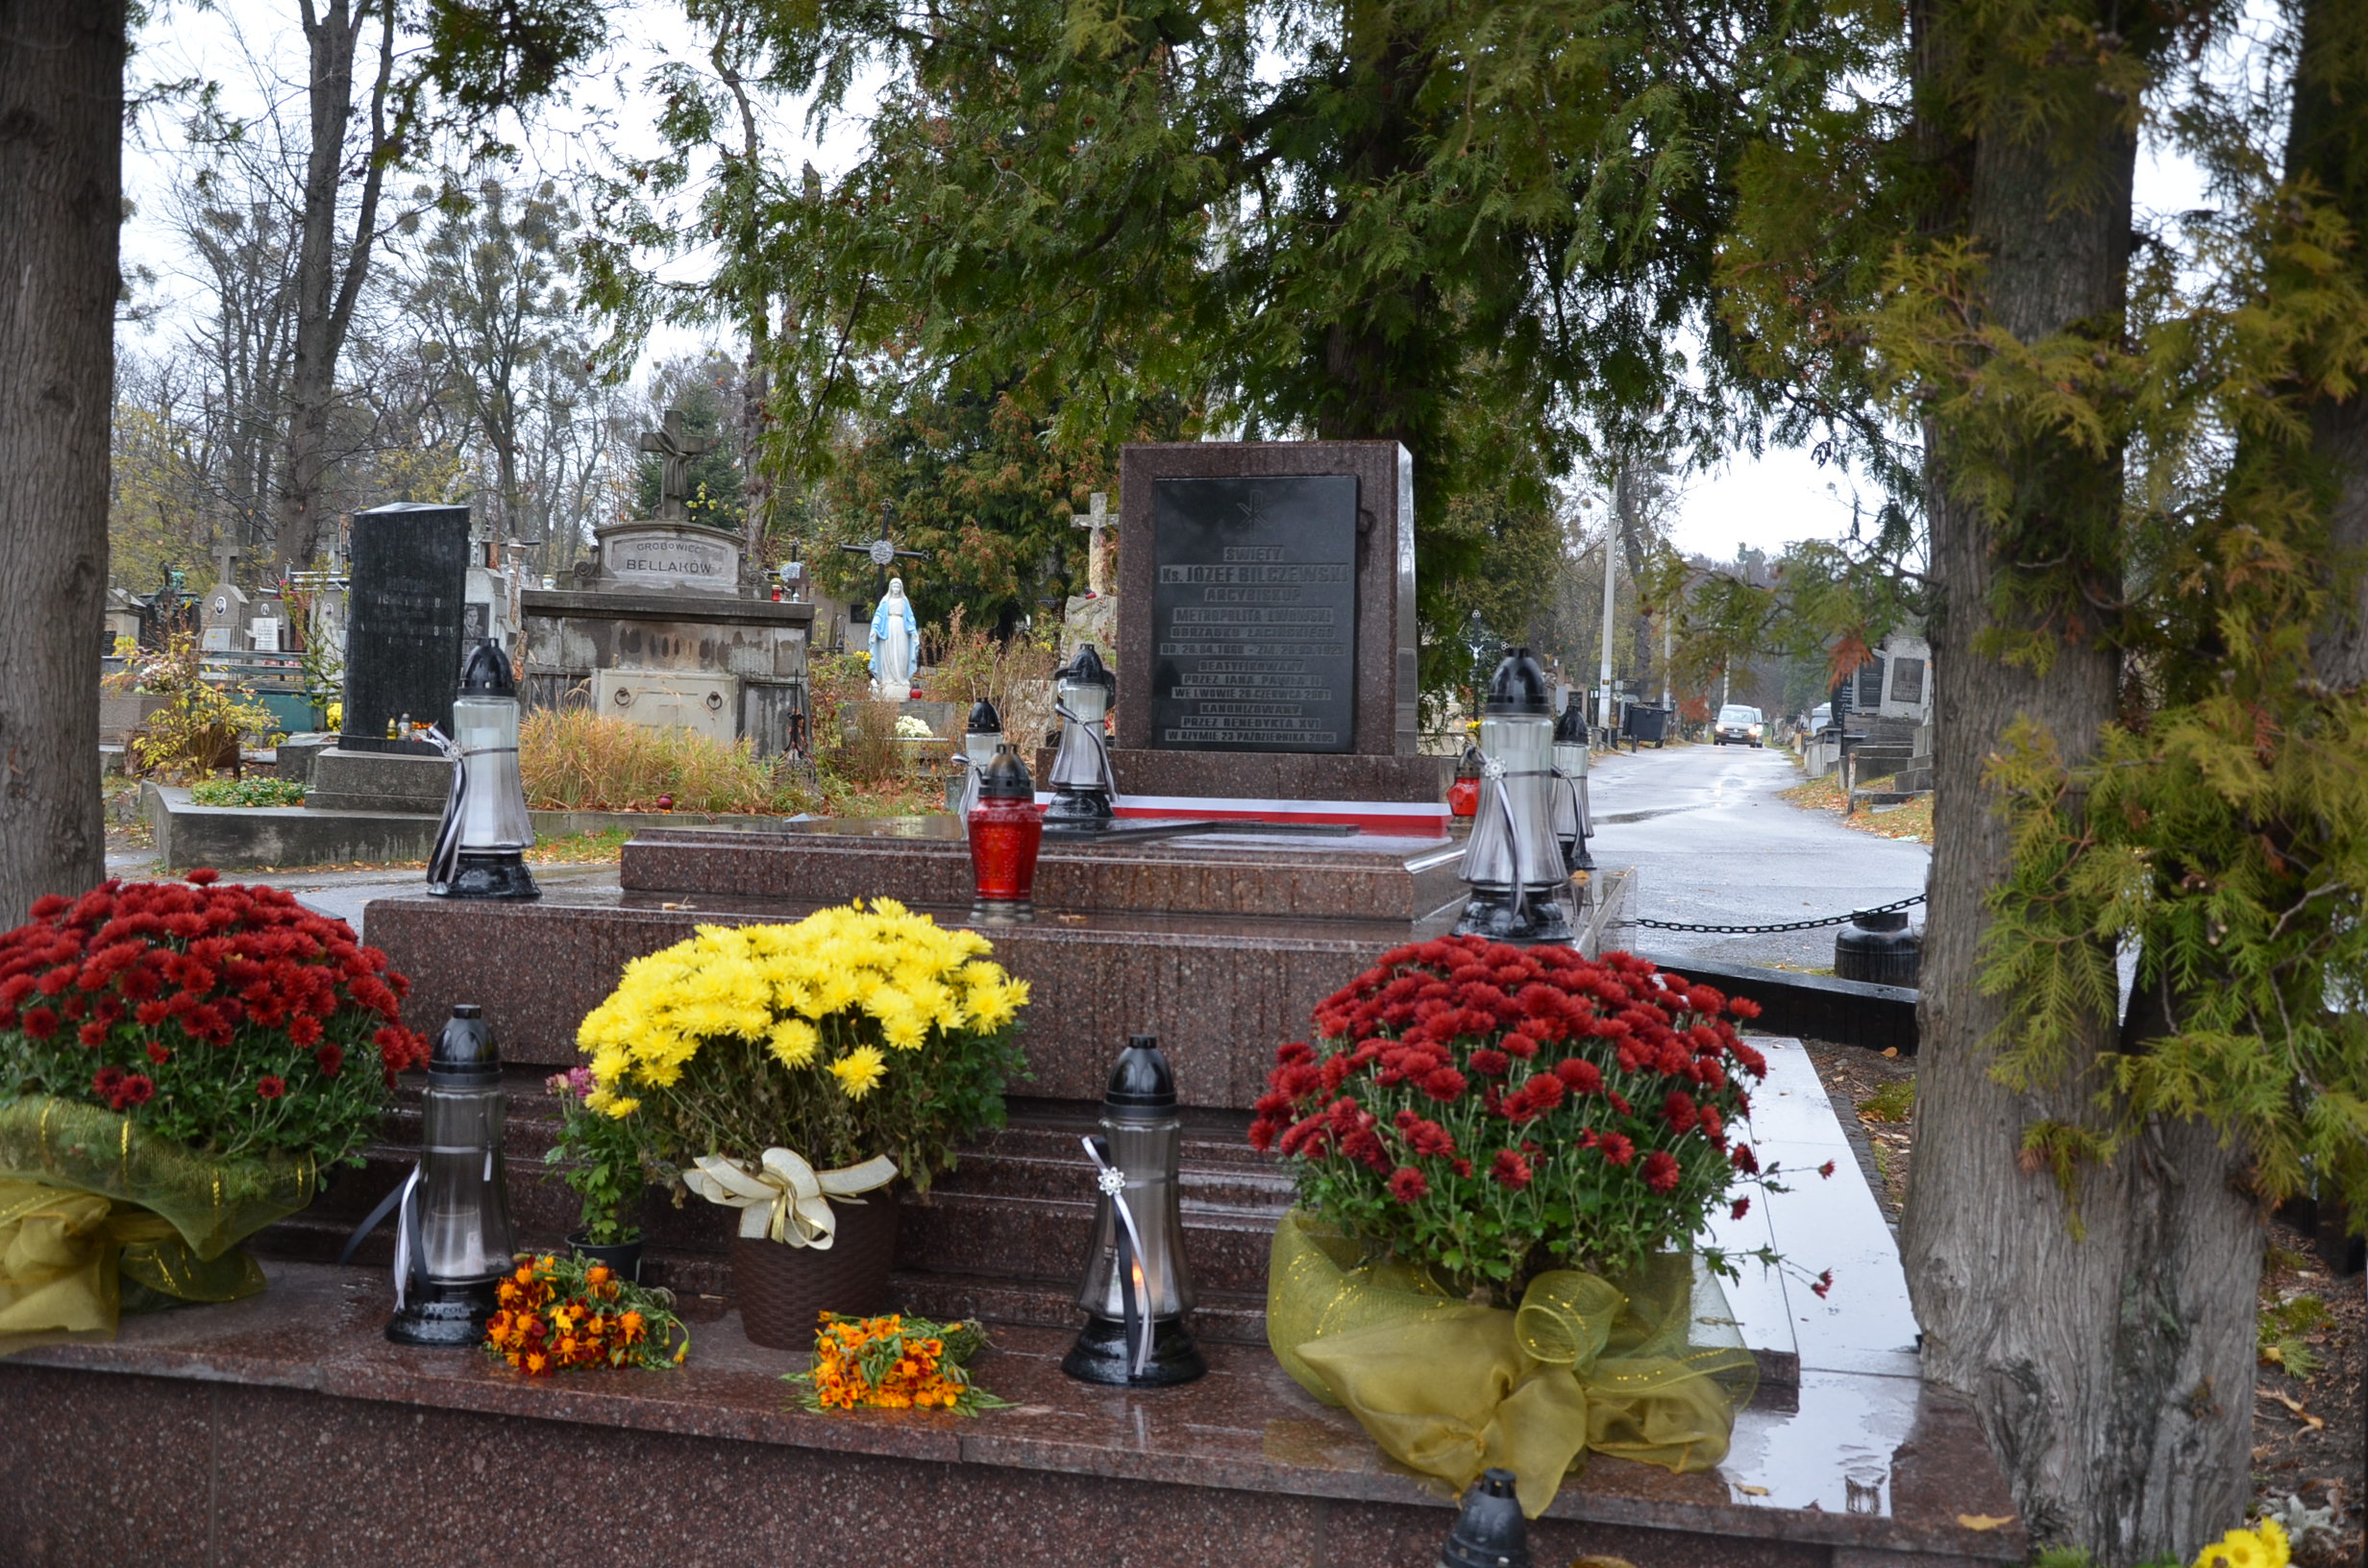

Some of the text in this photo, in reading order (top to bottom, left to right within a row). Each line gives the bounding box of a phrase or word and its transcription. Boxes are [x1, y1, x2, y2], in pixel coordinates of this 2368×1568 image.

[636, 542, 703, 554] GROBOWIEC
[626, 559, 711, 574] BELLAKÓW
[1163, 565, 1347, 582] Ks. JÓZEF BILCZEWSKI
[1206, 588, 1301, 601] ARCYBISKUP
[1175, 609, 1331, 623] METROPOLITA LWOWSKI
[1199, 661, 1304, 672] BEATYFIKOWANY
[1183, 674, 1219, 684] PRZEZ
[1261, 675, 1305, 686] PAWŁA
[1174, 688, 1192, 698] WE
[1194, 688, 1236, 698] LWOWIE
[1254, 689, 1301, 699] CZERWCA
[1201, 704, 1300, 714] KANONIZOWANY
[1183, 718, 1320, 728] PRZEZ BENEDYKTA XVI
[1168, 730, 1334, 743] W RZYMIE 23 PAŹDZIERNIKA 2005
